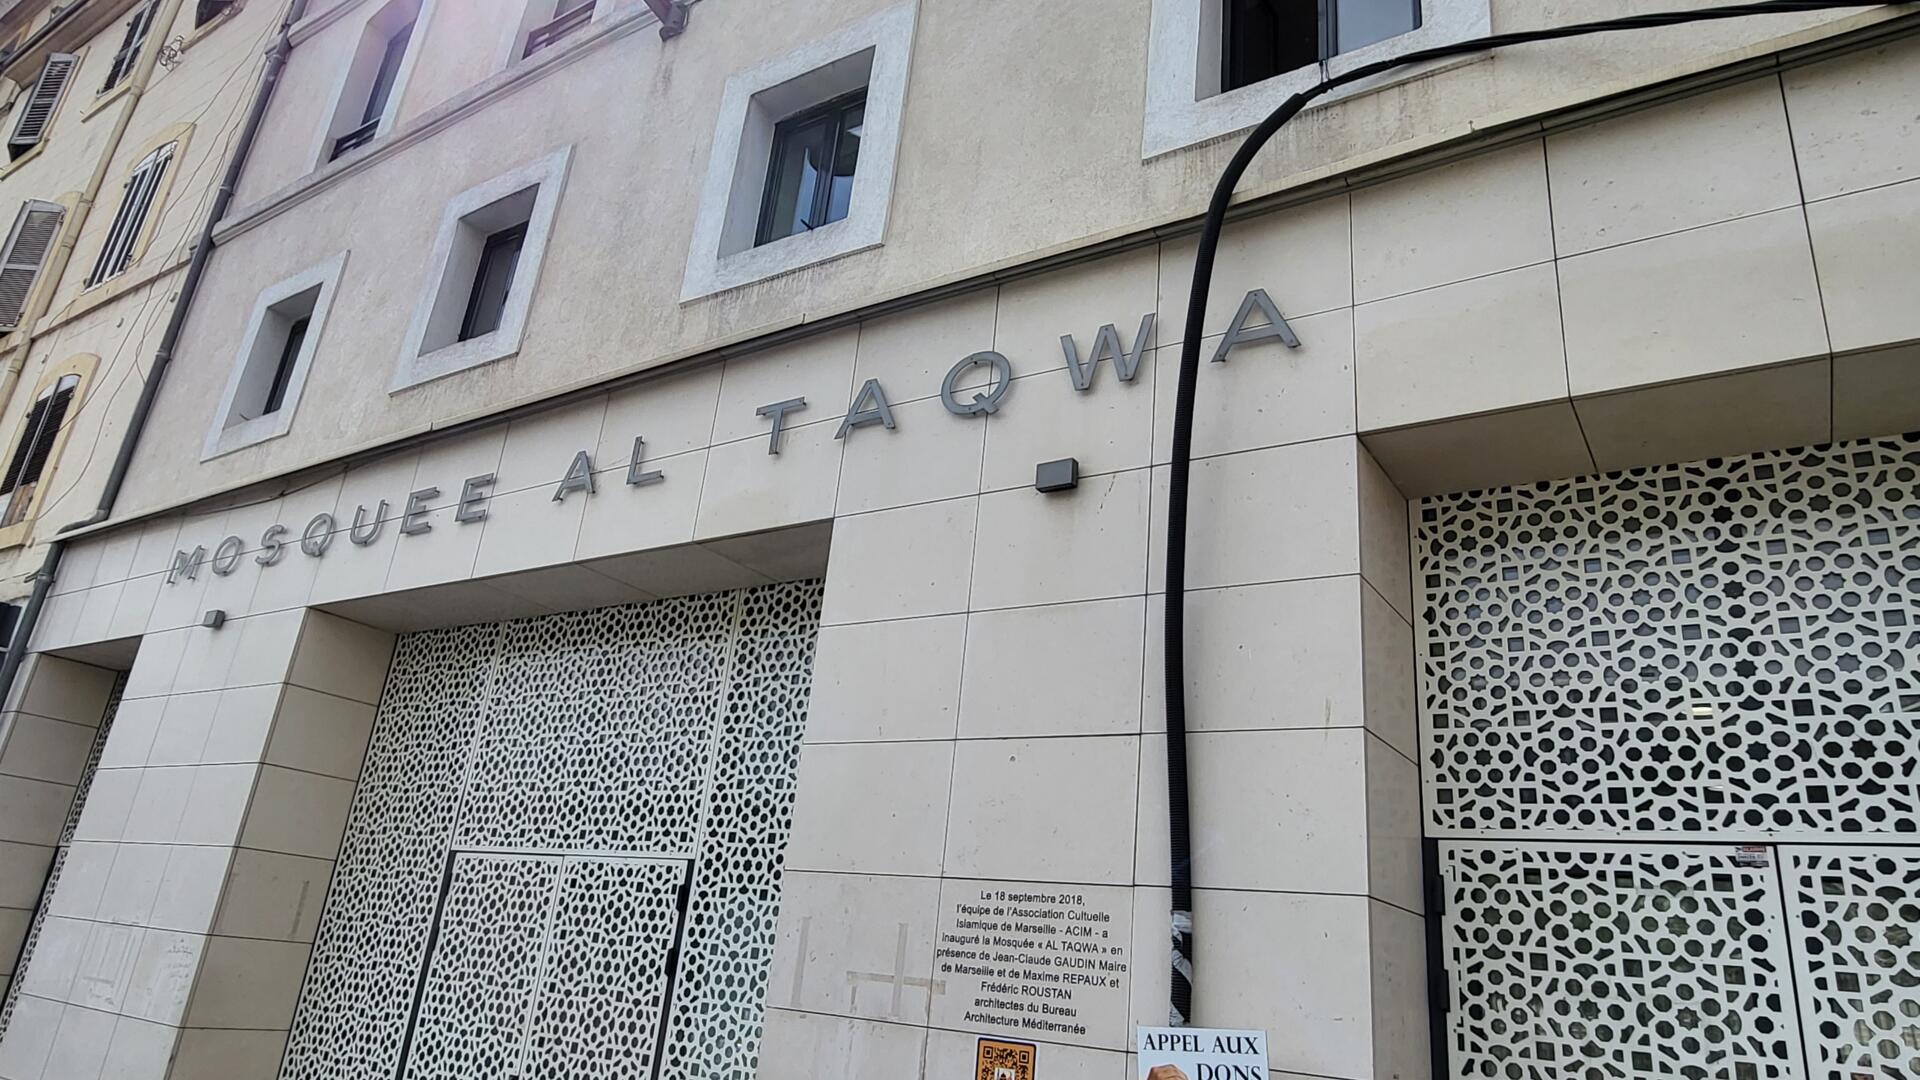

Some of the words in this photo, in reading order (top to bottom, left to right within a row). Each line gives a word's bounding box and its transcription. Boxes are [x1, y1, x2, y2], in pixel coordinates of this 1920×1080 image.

[167, 473, 495, 584] MOSQUEE
[552, 435, 664, 502] AL
[756, 288, 1301, 455] TAQWA
[980, 890, 992, 900] Le
[995, 890, 1006, 901] 18
[1008, 892, 1056, 904] septembre
[1059, 894, 1085, 906] 2018,
[993, 906, 1004, 916] de
[1067, 910, 1110, 922] Cultuelle
[956, 918, 998, 932] Islamique
[1000, 921, 1012, 931] de
[1014, 922, 1056, 934] Marseille
[1065, 926, 1092, 937] ACIM
[1102, 930, 1108, 938] a
[982, 935, 990, 945] la
[993, 936, 1034, 949] Mosquée
[1045, 940, 1058, 951] AL
[1061, 941, 1099, 954] TAQWA
[1110, 947, 1123, 956] en
[936, 948, 976, 960] présence
[979, 951, 990, 960] de
[992, 952, 1051, 966] Jean-Claude
[1054, 956, 1096, 970] GAUDIN
[1098, 959, 1127, 972] Maire
[941, 963, 952, 973] de
[954, 963, 995, 977] Marseille
[997, 967, 1006, 978] et
[1008, 968, 1020, 979] de
[1022, 969, 1060, 982] Maxime
[1062, 972, 1107, 987] REPAUX
[1109, 978, 1120, 988] et
[980, 981, 1019, 995] Frédéric
[1021, 985, 1072, 1000] ROUSTAN
[974, 998, 1024, 1011] architectes
[1027, 1002, 1039, 1013] du
[1042, 1003, 1077, 1017] Bureau
[963, 1011, 1019, 1027] Architecture
[1021, 1017, 1086, 1035] Méditerranée
[1143, 1033, 1204, 1053] APPEL
[1212, 1035, 1259, 1055] AUX
[1196, 1063, 1262, 1080] DONS
